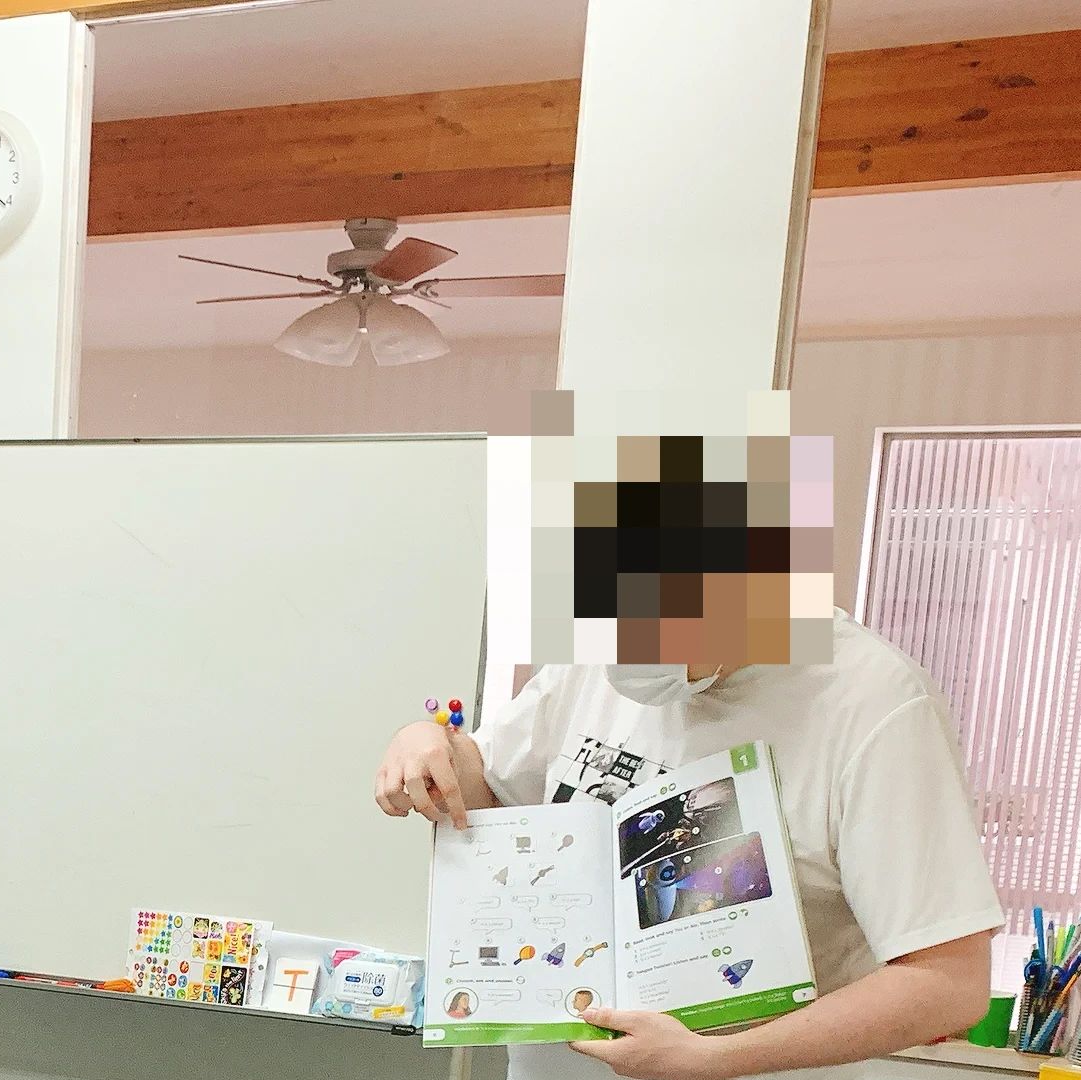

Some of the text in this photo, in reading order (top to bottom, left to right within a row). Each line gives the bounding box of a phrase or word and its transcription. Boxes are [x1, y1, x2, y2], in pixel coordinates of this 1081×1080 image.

[8, 150, 16, 162] 2
[12, 171, 20, 184] 3
[6, 194, 13, 205] 4
[740, 755, 748, 766] 1
[284, 970, 309, 1001] T
